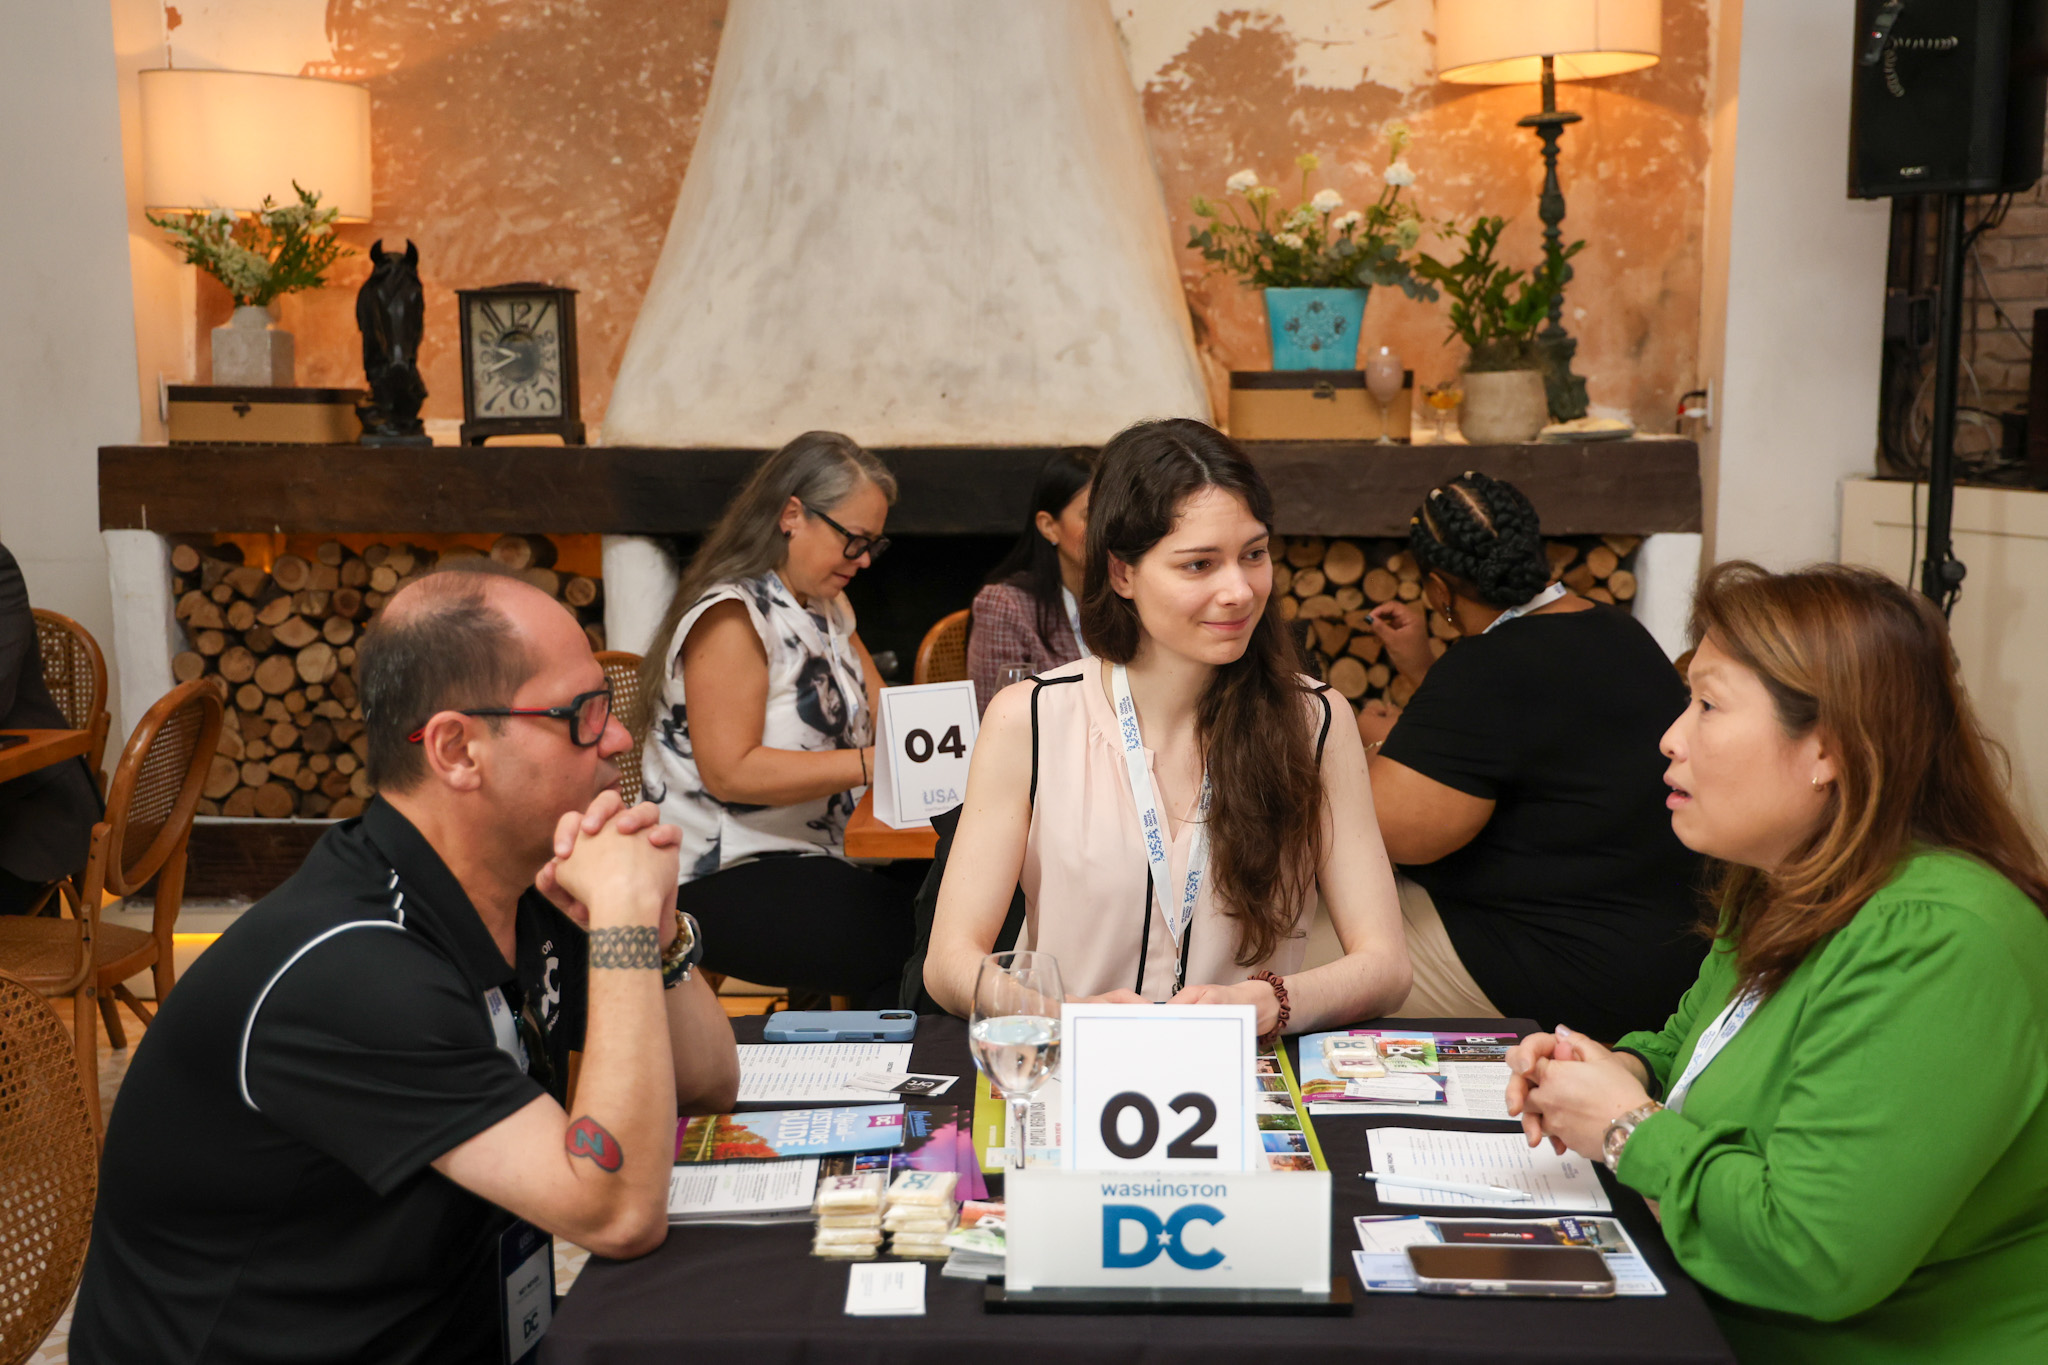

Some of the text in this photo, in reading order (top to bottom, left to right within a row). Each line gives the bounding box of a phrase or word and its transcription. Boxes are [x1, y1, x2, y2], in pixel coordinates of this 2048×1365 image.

[905, 725, 966, 763] 04
[923, 788, 960, 805] USA
[1333, 1041, 1367, 1049] DC
[1386, 1047, 1423, 1055] DC
[776, 1110, 812, 1148] GUIDE
[808, 1109, 833, 1145] VISITORS
[1100, 1091, 1218, 1160] 02
[1102, 1203, 1226, 1271] DC
